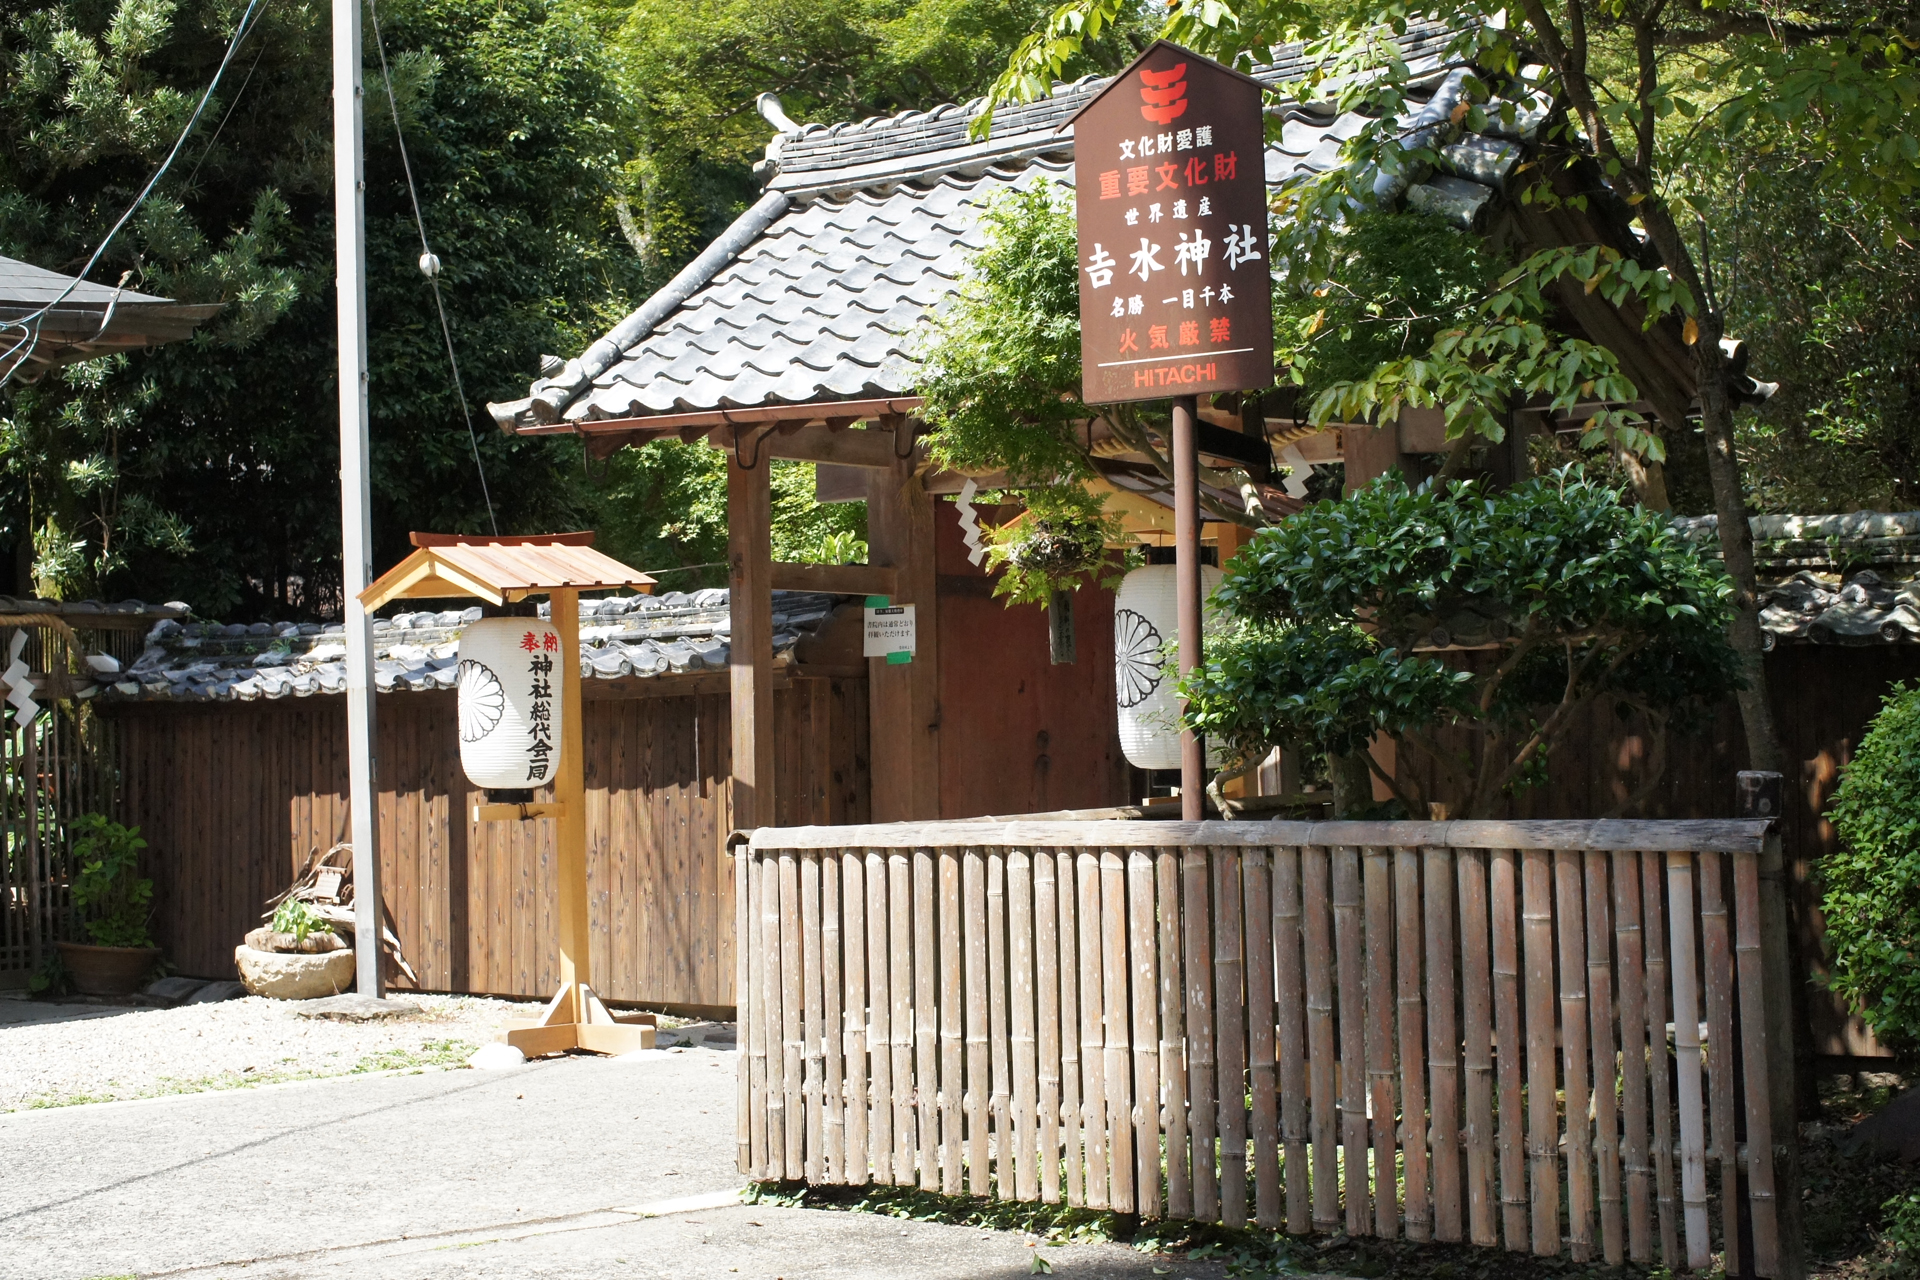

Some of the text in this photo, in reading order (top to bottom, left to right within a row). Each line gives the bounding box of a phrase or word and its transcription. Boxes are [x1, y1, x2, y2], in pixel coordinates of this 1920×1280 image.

[1119, 125, 1213, 161] 文化財愛護
[1099, 151, 1237, 200] 重要文化財
[1124, 196, 1213, 226] 世界遺産
[1110, 283, 1235, 318] 名勝 一目千本
[1119, 316, 1231, 353] 火気厳禁
[1134, 362, 1217, 388] HITACHI
[526, 653, 554, 781] 神社総代会一同
